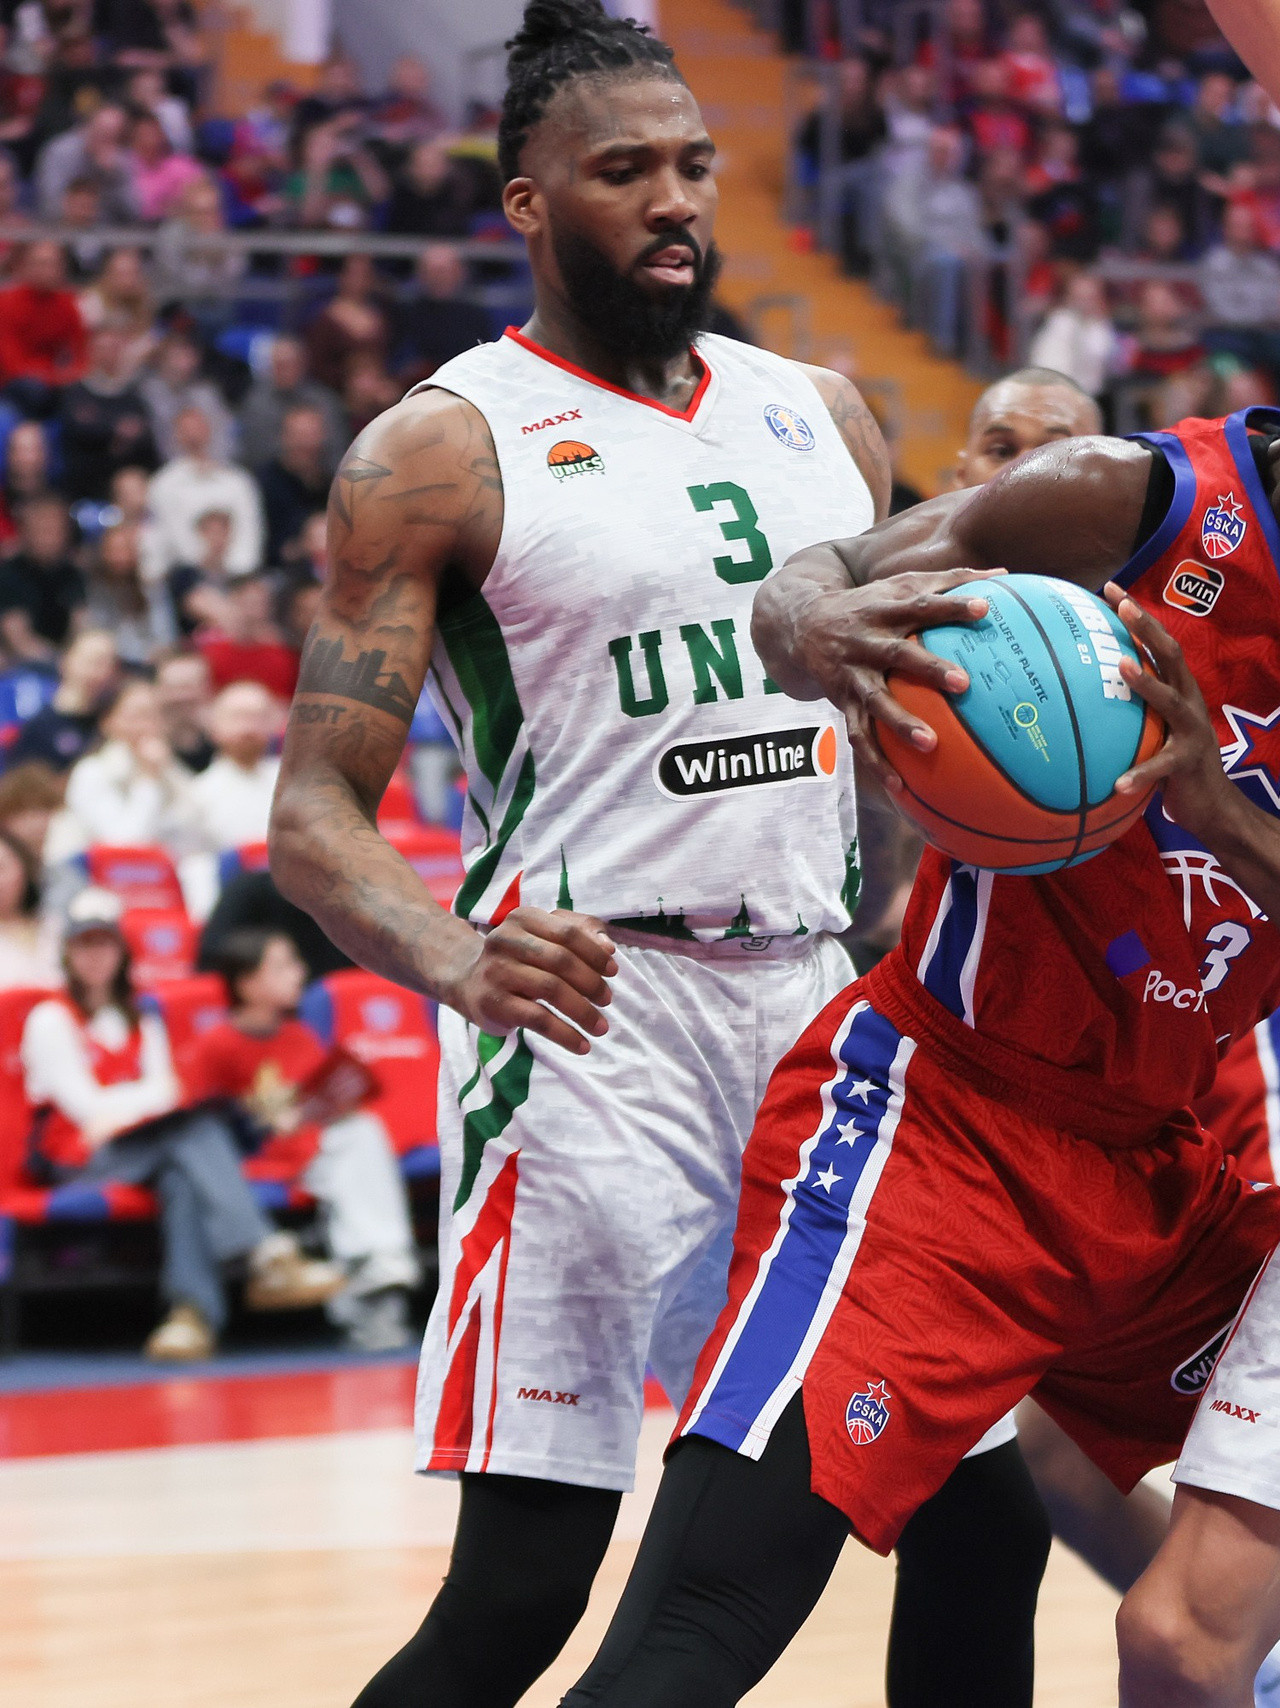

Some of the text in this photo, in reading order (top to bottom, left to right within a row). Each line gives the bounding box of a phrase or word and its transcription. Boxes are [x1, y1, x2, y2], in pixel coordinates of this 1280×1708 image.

[521, 409, 583, 434] MAXX
[548, 456, 605, 479] UNICS
[686, 481, 773, 585] 3
[1206, 513, 1239, 538] CSKA
[1180, 576, 1215, 603] Win
[999, 620, 1016, 644] LIFE
[1010, 643, 1024, 661] OF
[1018, 657, 1050, 704] PLASTIC
[1076, 643, 1092, 665] 2.0
[608, 618, 788, 718] UN
[674, 741, 805, 786] Winline
[1199, 920, 1252, 993] 3
[517, 1388, 580, 1406] MAXX
[853, 1400, 883, 1427] CSKA
[1209, 1400, 1261, 1424] MAXX
